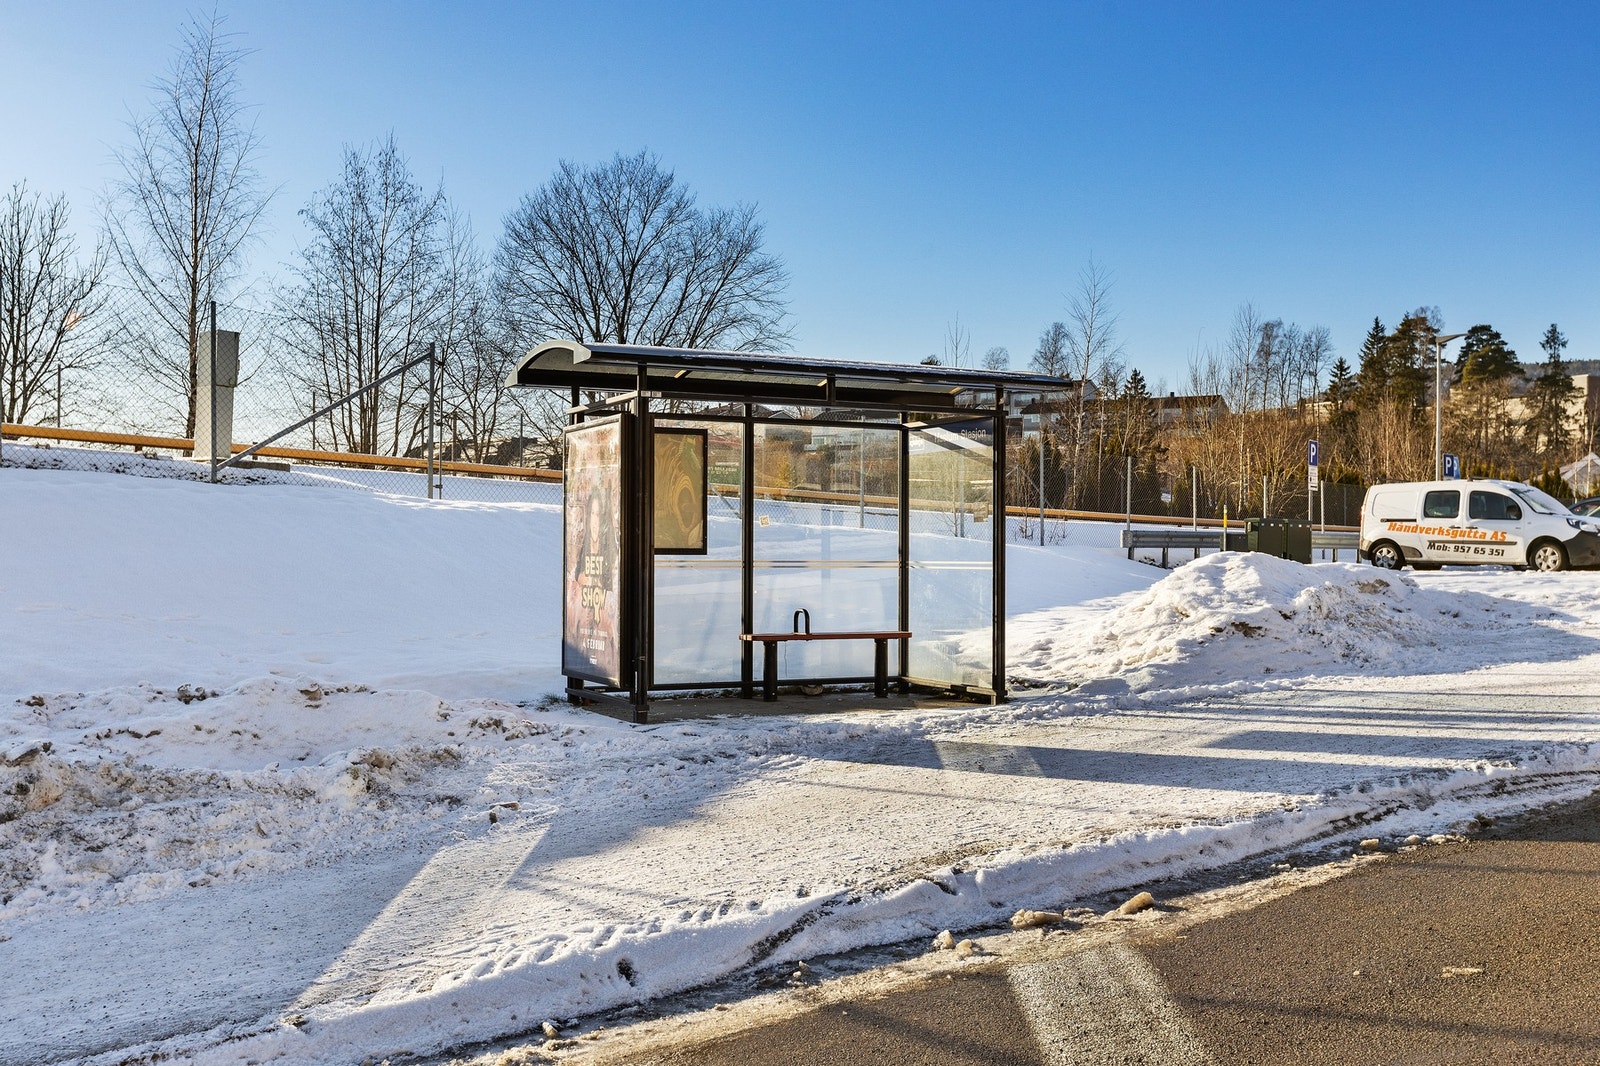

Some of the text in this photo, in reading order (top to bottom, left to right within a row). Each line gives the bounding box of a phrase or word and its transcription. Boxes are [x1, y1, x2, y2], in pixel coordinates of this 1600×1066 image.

[1310, 443, 1317, 463] P
[1445, 456, 1452, 474] P
[1490, 531, 1508, 541] AS
[1427, 541, 1505, 556] Mob: 957 65 351
[585, 556, 603, 575] BEST
